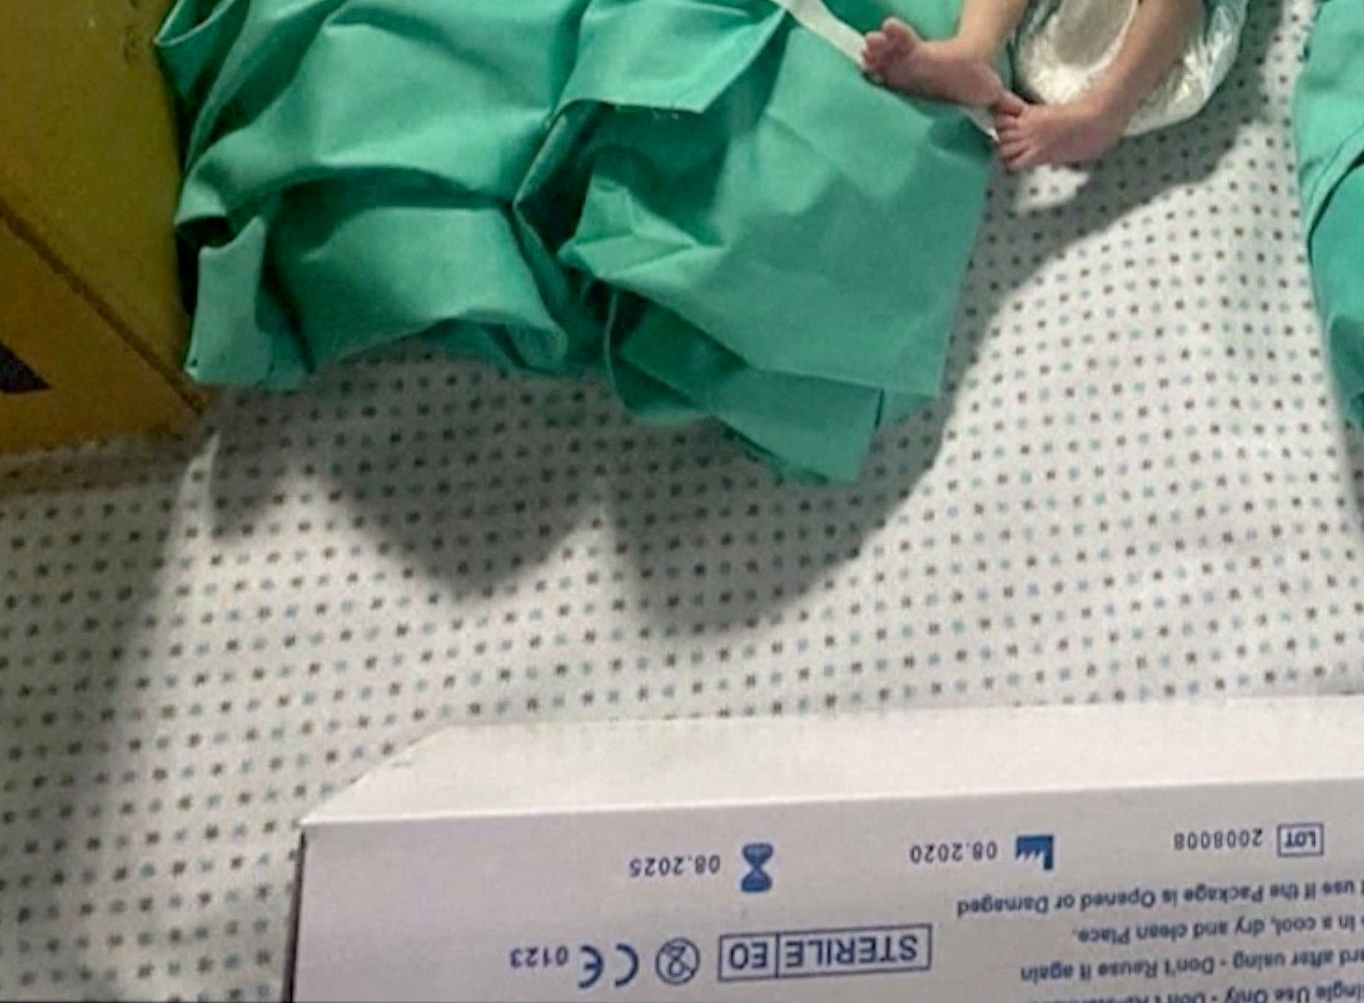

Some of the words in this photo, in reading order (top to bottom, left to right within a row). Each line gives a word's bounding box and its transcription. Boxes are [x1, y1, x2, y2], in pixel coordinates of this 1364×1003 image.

[1173, 828, 1263, 850] 2008008
[1284, 830, 1317, 848] LOT
[910, 841, 997, 863] 08.2020
[628, 855, 721, 877] 08.2025
[1185, 884, 1263, 903] Package
[1270, 884, 1298, 899] the
[1304, 883, 1316, 899] if
[1323, 881, 1355, 895] use
[957, 895, 1049, 917] Damaged
[1056, 896, 1075, 912] or
[1081, 888, 1155, 911] Opened
[1163, 890, 1178, 906] is
[1137, 924, 1187, 941] clean
[1194, 923, 1228, 939] and
[1235, 916, 1265, 937] dry
[1270, 916, 1316, 936] cool,
[1323, 917, 1332, 931] a
[1339, 915, 1355, 935] in
[1072, 927, 1131, 945] Place.
[510, 945, 568, 968] 0123
[728, 934, 768, 970] EO
[782, 933, 920, 969] STERILE
[1233, 951, 1285, 970] using
[1293, 949, 1334, 970] after
[1021, 961, 1073, 985] again
[1080, 964, 1091, 982] it
[1098, 961, 1157, 980] Reuse
[1164, 957, 1214, 976] Don't
[1224, 987, 1268, 1003] Only
[1275, 986, 1310, 1003] Use
